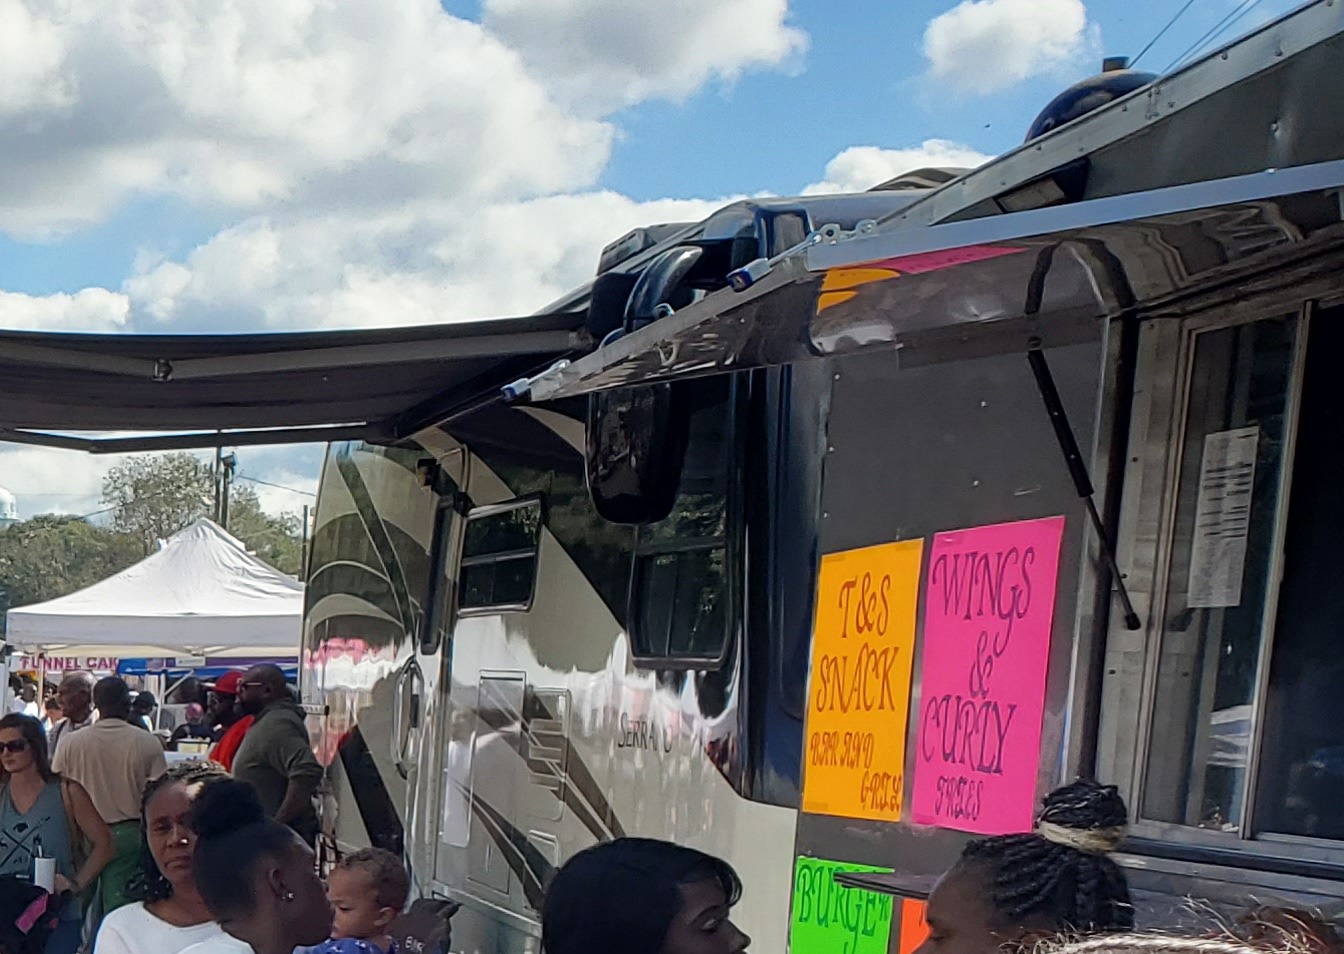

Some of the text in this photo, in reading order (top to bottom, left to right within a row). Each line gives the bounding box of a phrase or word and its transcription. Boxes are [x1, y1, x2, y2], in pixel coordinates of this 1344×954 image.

[932, 546, 1035, 656] WINGS
[19, 655, 81, 670] FUNNEL
[815, 641, 900, 714] SNACK
[968, 630, 994, 700] &
[617, 711, 673, 753] SERRAO
[810, 731, 874, 769] BAR AND
[921, 694, 1018, 775] CURLY
[934, 775, 984, 822] FRIES
